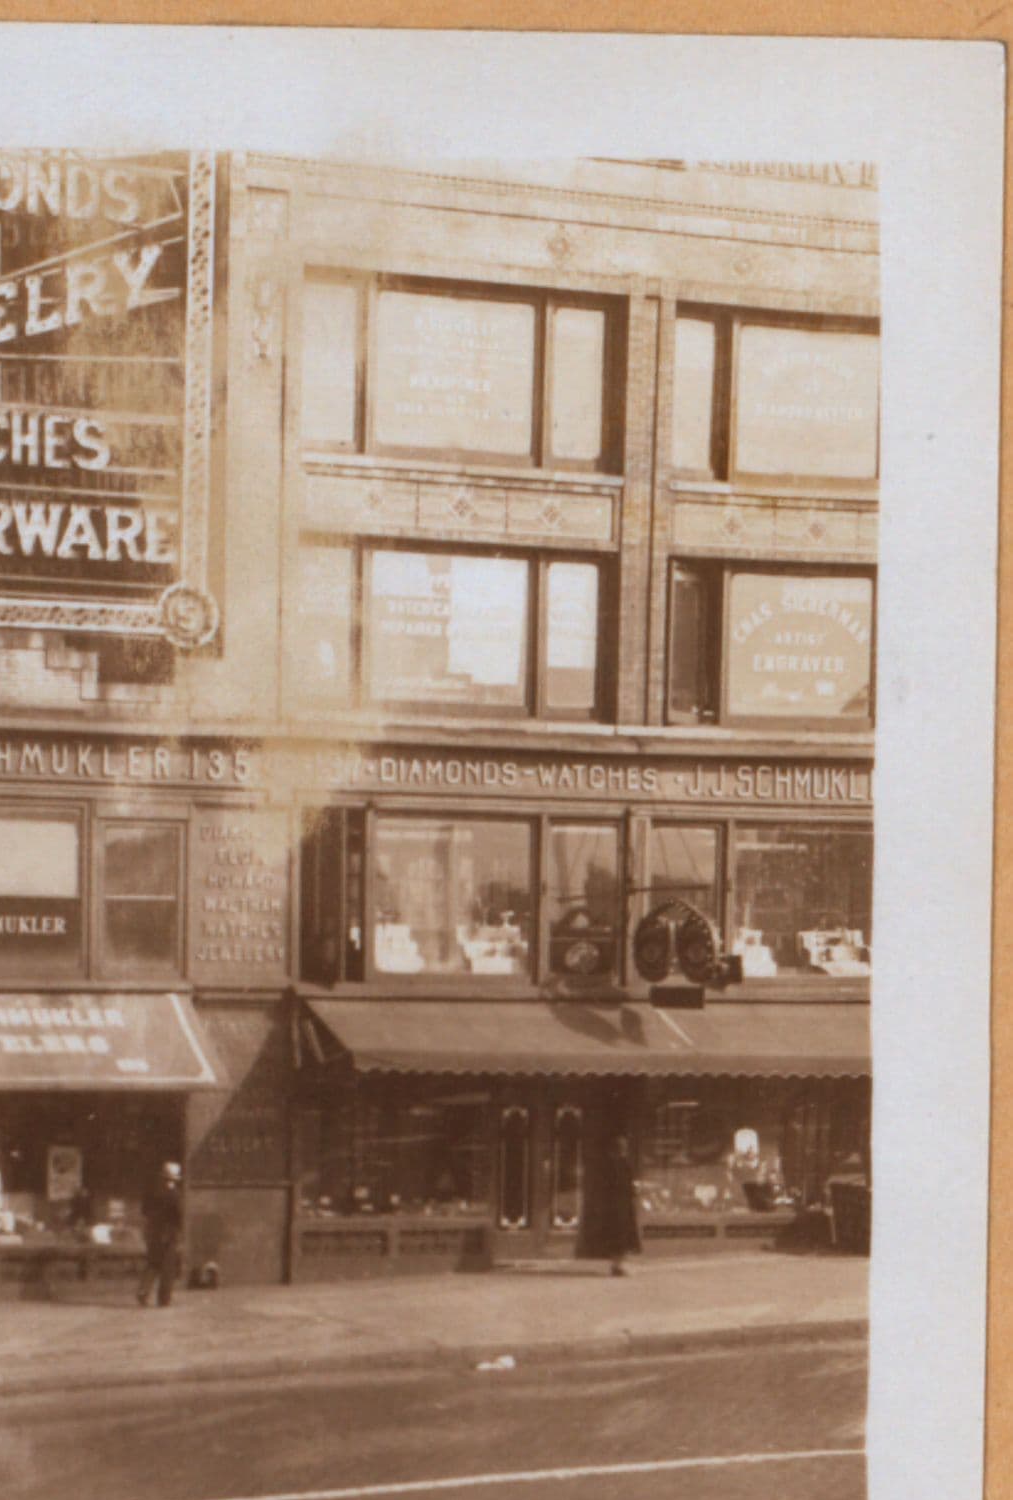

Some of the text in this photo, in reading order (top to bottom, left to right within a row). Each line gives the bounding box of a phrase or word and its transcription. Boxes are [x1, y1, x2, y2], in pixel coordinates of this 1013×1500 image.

[752, 654, 846, 674] ENGRAVER
[190, 748, 251, 782] 135
[737, 766, 874, 801] SCHMUKL
